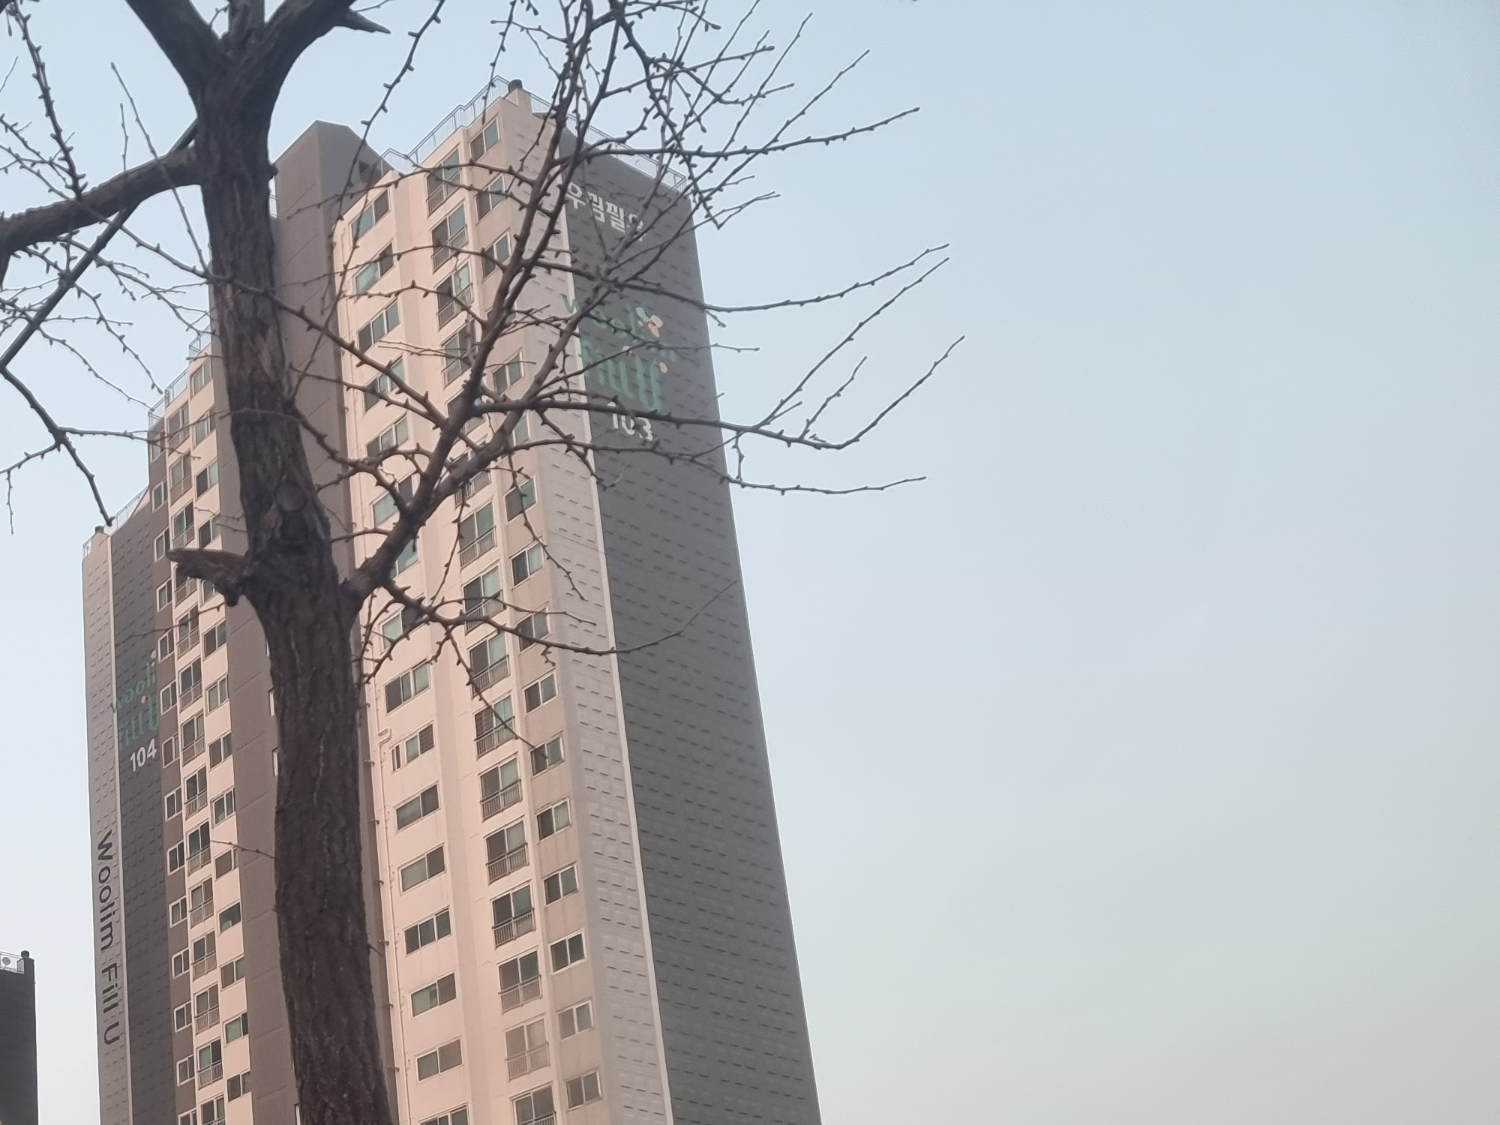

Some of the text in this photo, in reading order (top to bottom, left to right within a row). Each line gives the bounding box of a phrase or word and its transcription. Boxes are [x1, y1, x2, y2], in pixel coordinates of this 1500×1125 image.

[130, 738, 157, 772] 104
[98, 829, 120, 1046] Woolim Fill U
